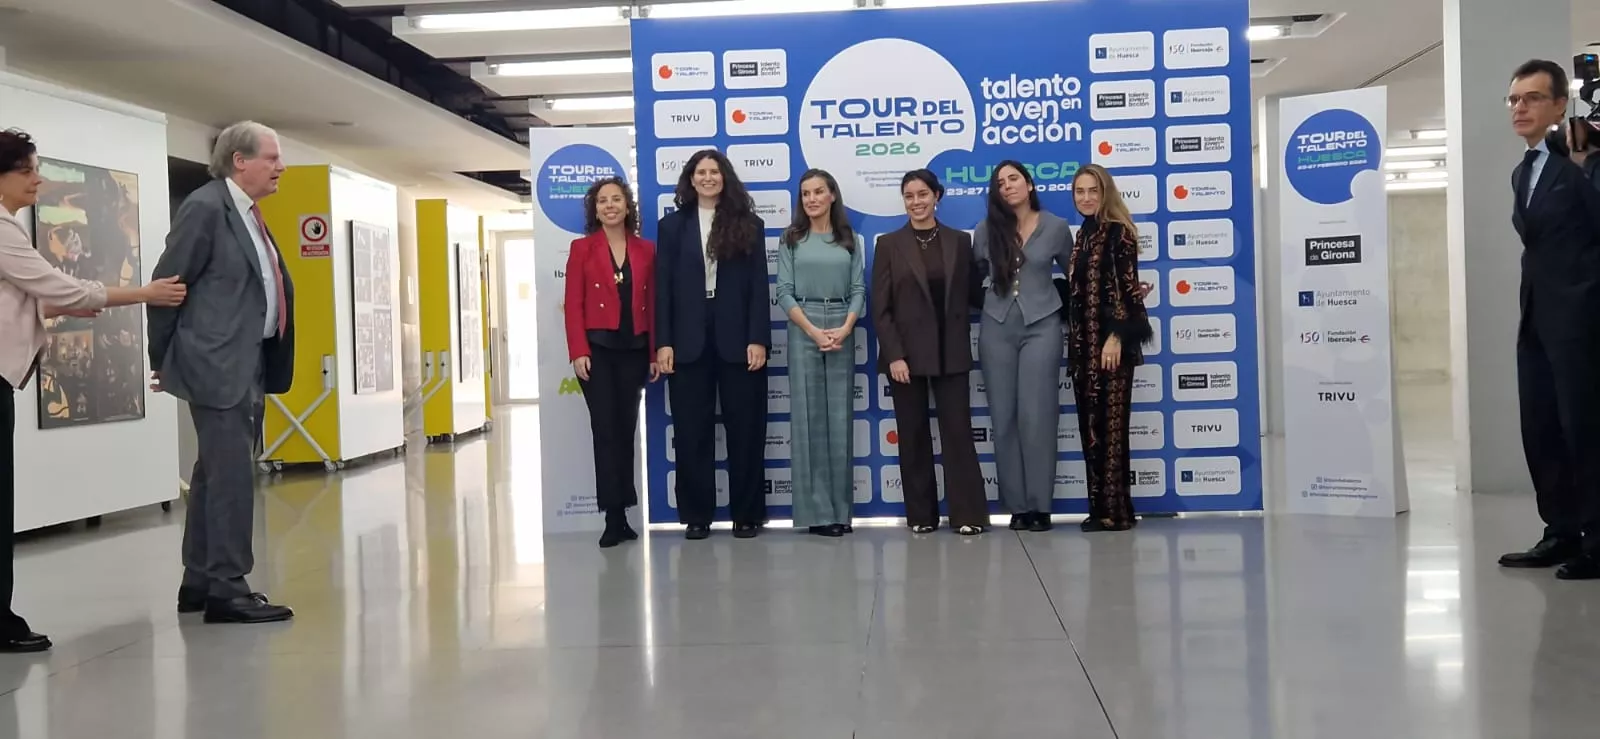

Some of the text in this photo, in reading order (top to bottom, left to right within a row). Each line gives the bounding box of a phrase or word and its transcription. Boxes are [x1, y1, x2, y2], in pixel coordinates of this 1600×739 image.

[980, 73, 1081, 100] talento
[810, 97, 964, 120] TOUR DEL
[982, 98, 1082, 127] joven en
[671, 114, 700, 123] TRIVU
[811, 119, 965, 138] TALENTO
[982, 116, 1082, 144] acción
[1297, 131, 1367, 144] TOUR DEL
[856, 142, 920, 156] 2026
[1297, 140, 1367, 153] TALENTO
[744, 159, 773, 167] TRIVU
[548, 165, 595, 175] TOUR
[946, 162, 1080, 183] HUCA
[1310, 240, 1355, 250] Princesa
[1321, 250, 1355, 260] Girona
[1317, 289, 1370, 298] Ayuntamiento
[1328, 298, 1357, 306] Huesca
[1300, 331, 1320, 344] 150
[1318, 392, 1355, 401] TRIVU
